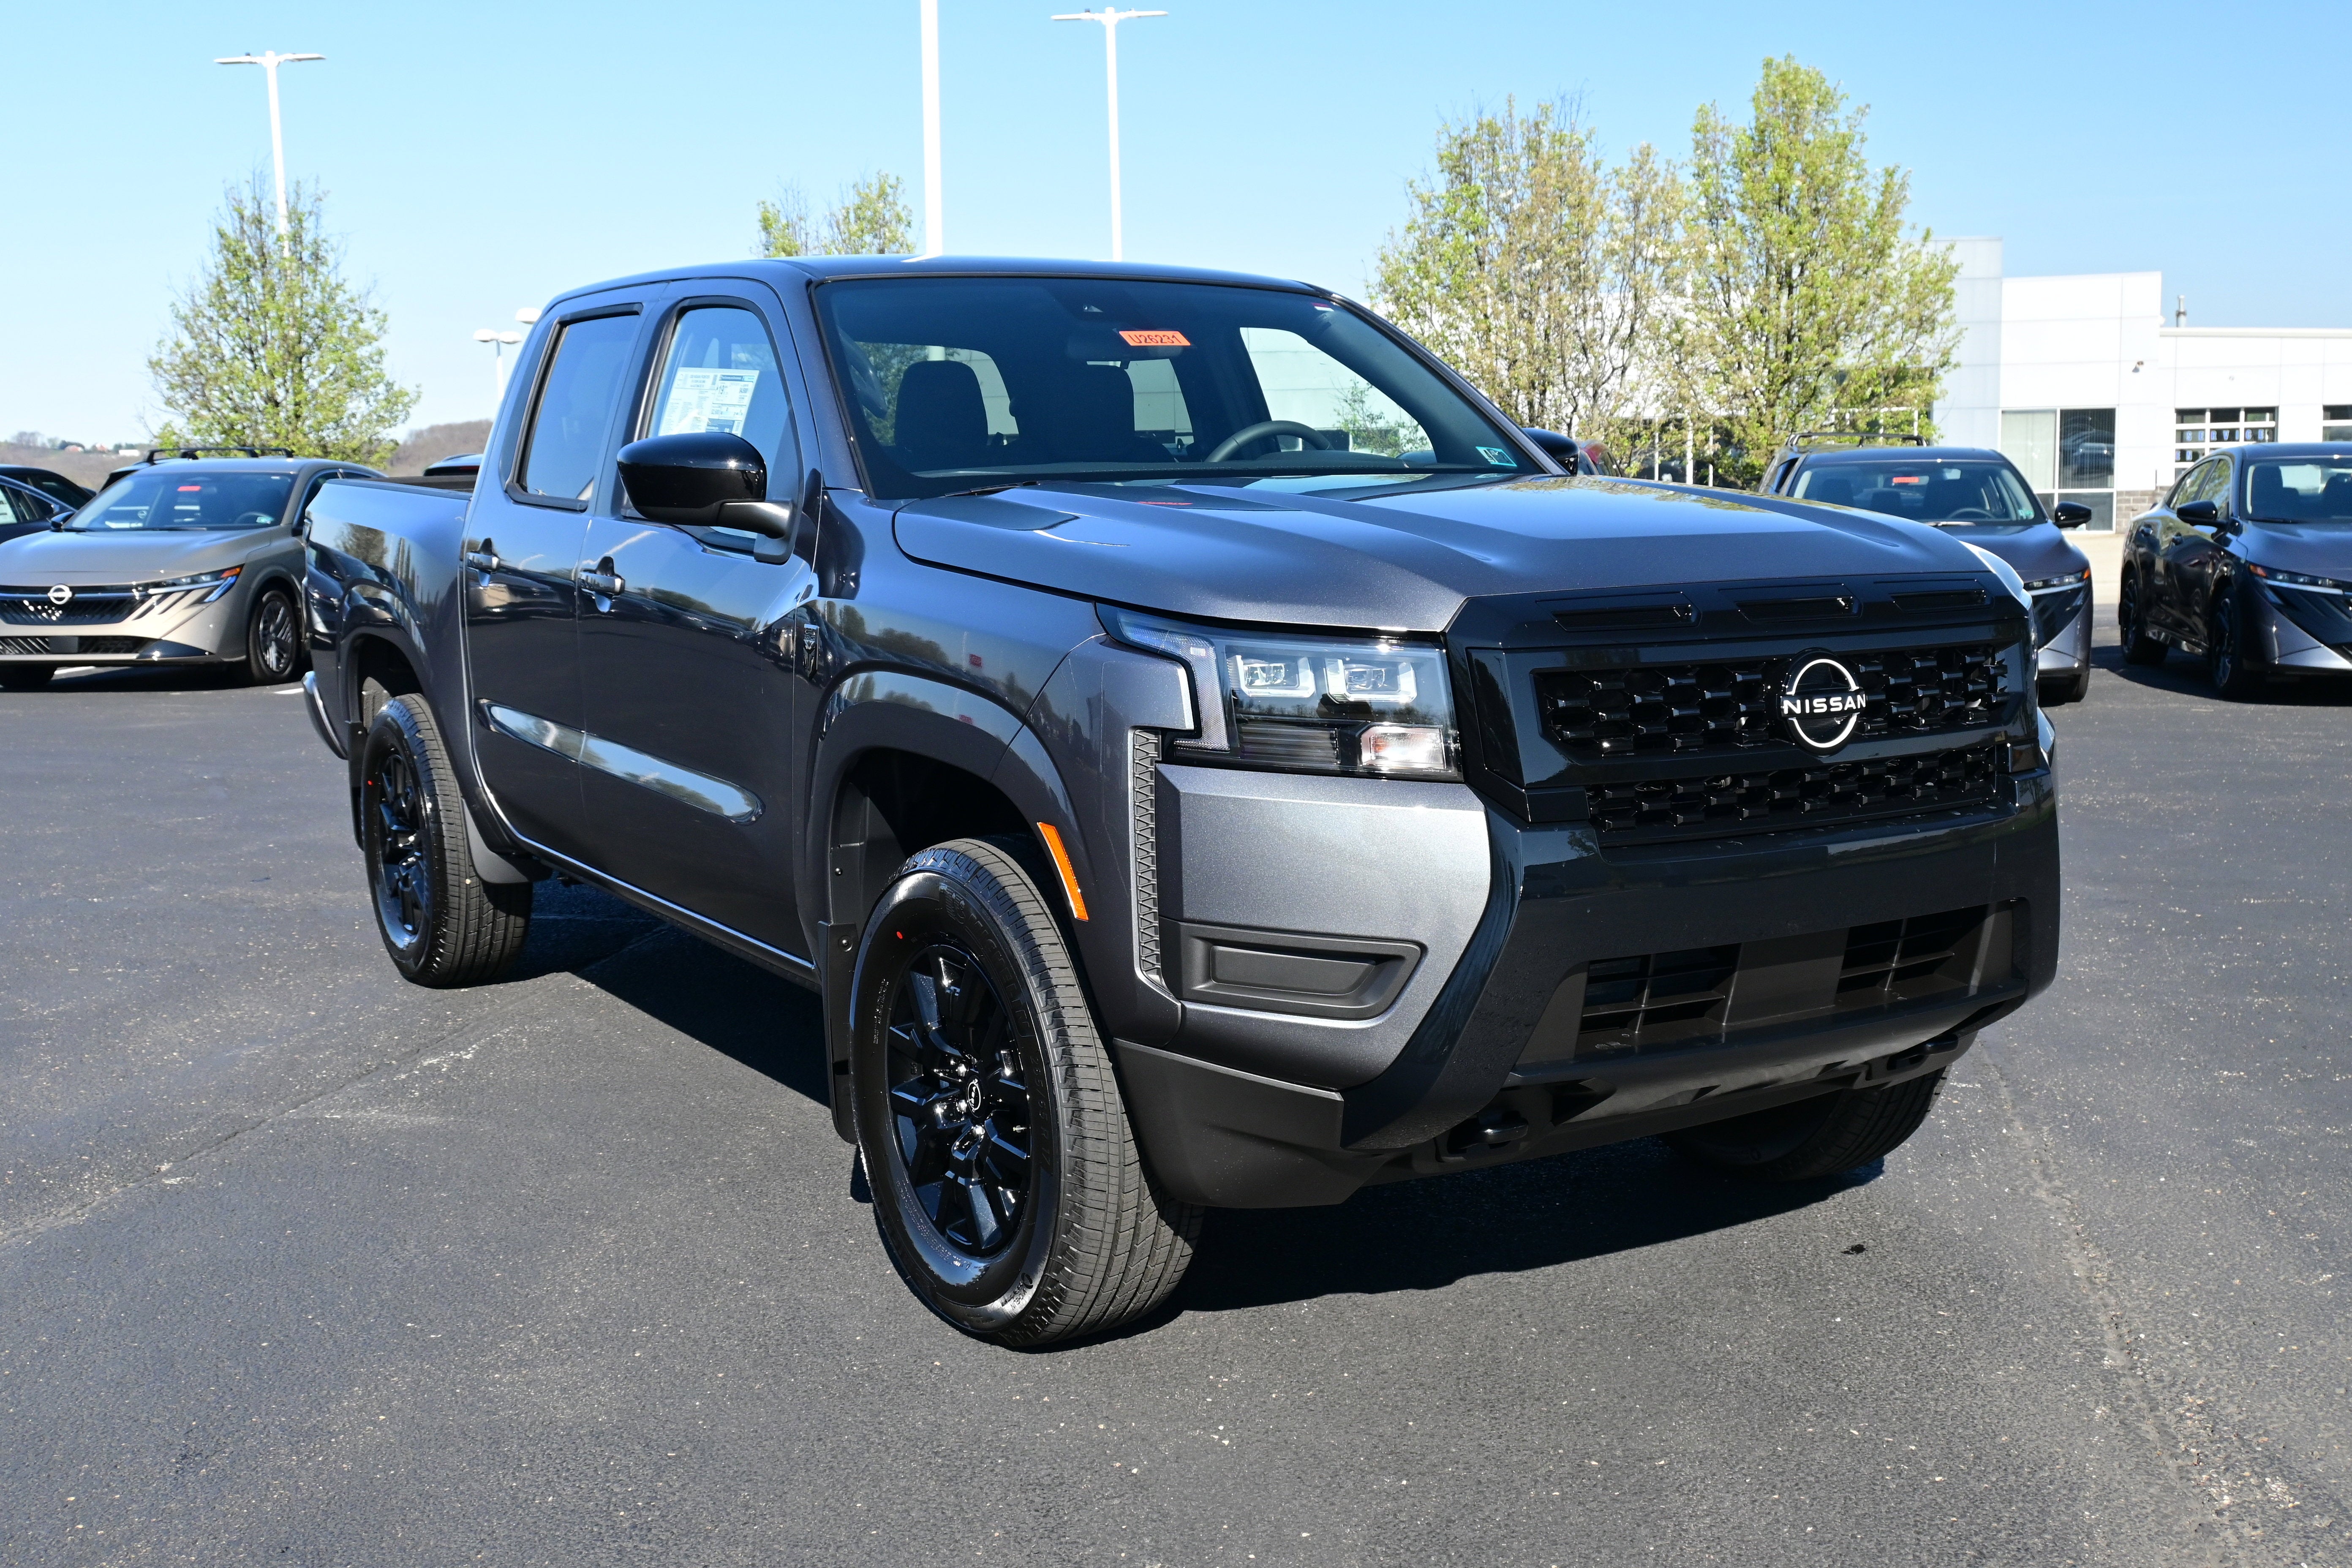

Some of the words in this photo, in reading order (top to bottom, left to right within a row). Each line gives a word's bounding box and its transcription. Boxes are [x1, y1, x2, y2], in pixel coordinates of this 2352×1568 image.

[1127, 334, 1182, 344] U26231
[2186, 429, 2264, 441] SERVICE
[1783, 694, 1866, 714] NISSAN
